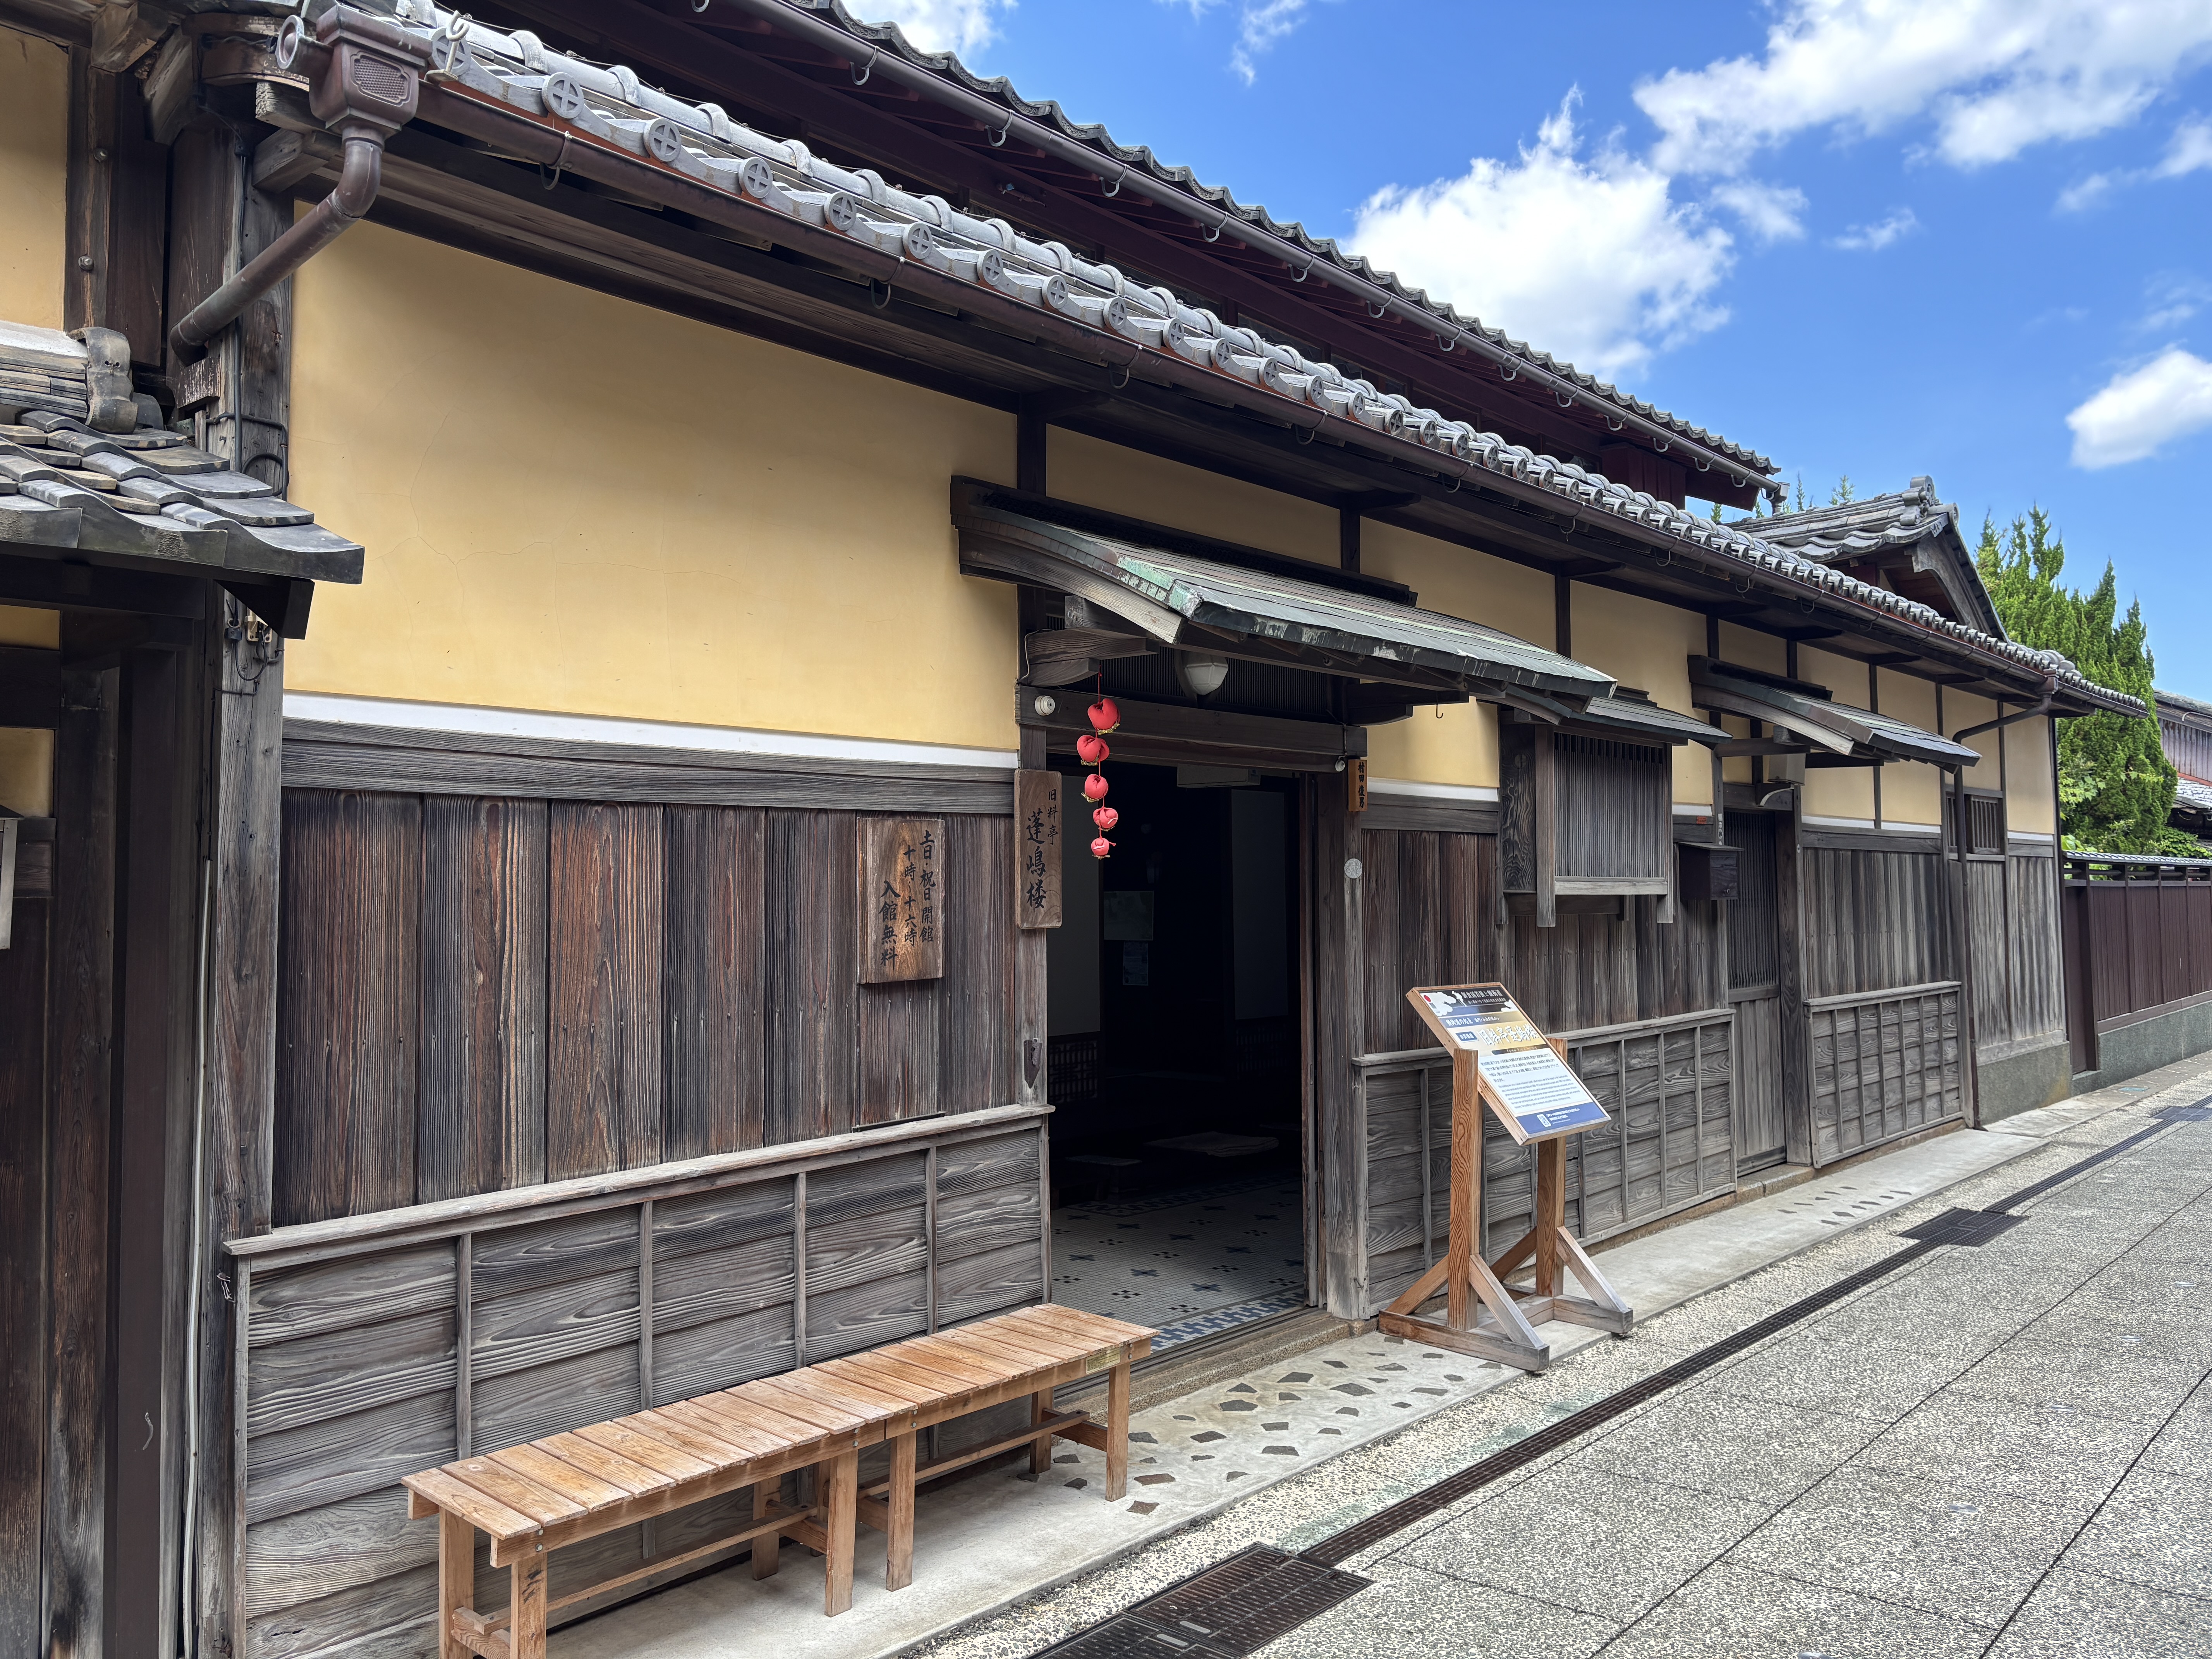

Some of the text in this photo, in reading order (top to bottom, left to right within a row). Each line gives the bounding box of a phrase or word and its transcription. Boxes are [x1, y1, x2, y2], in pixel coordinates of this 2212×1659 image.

[1027, 808, 1046, 908] 蓬嶋楼
[1048, 789, 1058, 845] 旧料亭
[878, 880, 900, 971] 入館無料
[919, 830, 936, 943] 土日・祝日開館
